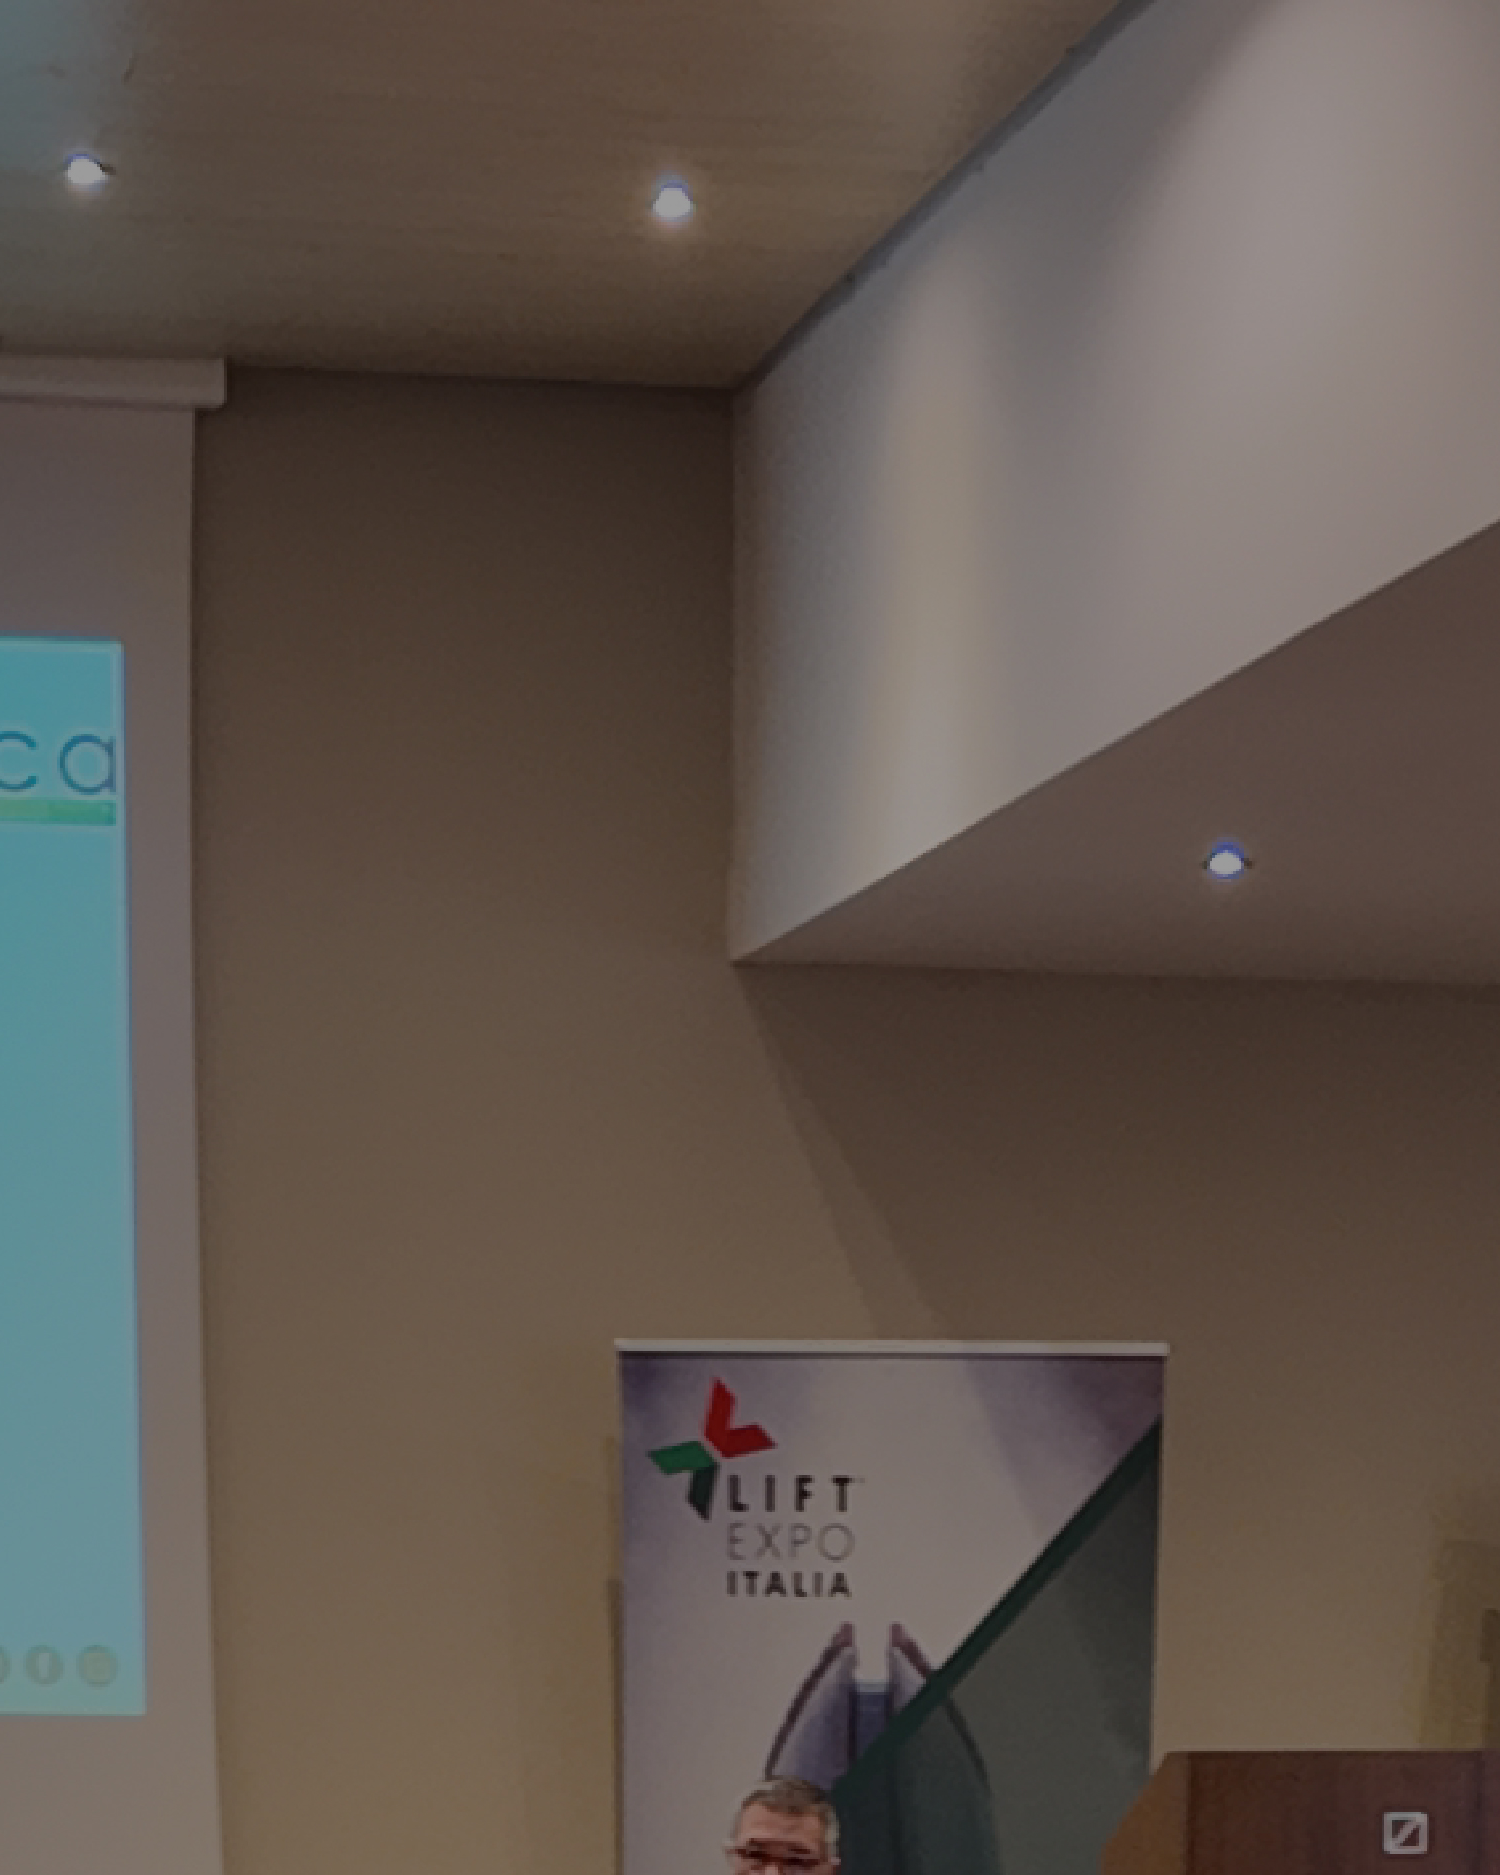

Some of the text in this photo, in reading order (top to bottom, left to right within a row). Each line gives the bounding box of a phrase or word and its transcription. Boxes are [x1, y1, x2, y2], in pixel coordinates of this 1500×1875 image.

[726, 1474, 853, 1513] LIFT
[727, 1523, 856, 1562] EXPO
[726, 1570, 851, 1598] ITALIA
